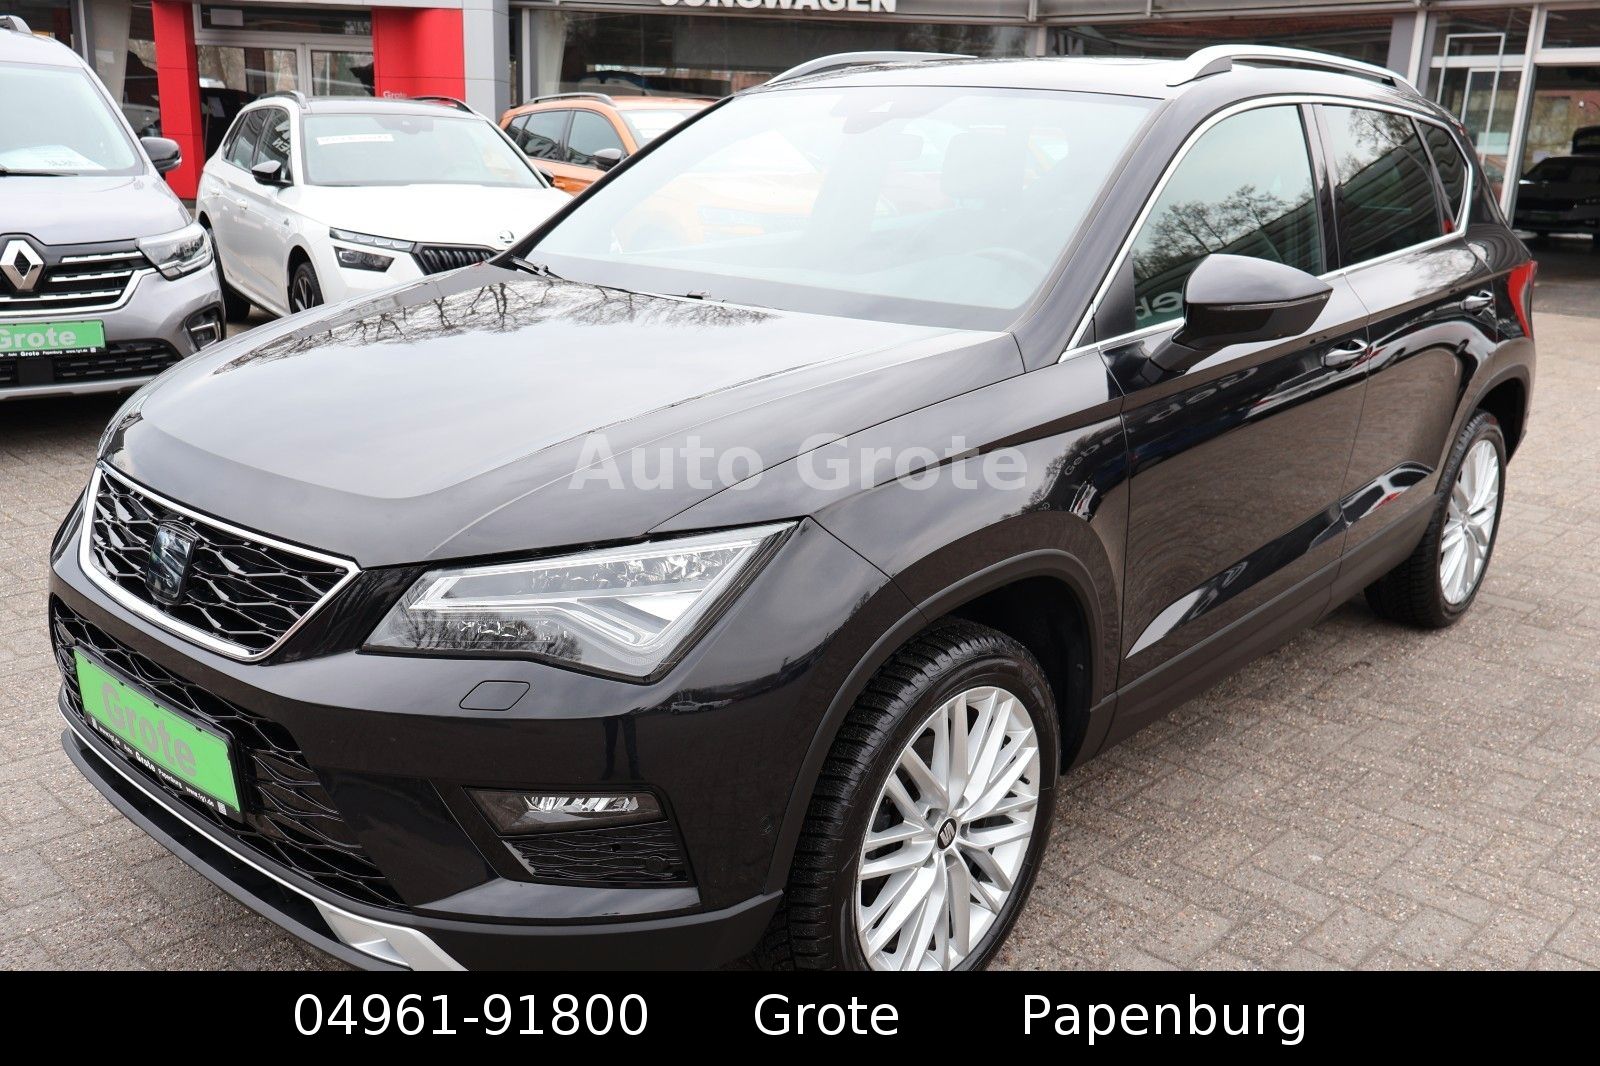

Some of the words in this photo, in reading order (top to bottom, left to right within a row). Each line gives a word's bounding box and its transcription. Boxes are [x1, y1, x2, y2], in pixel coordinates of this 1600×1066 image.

[0, 327, 77, 348] Grote
[102, 683, 196, 776] Grote
[135, 752, 155, 772] Grote
